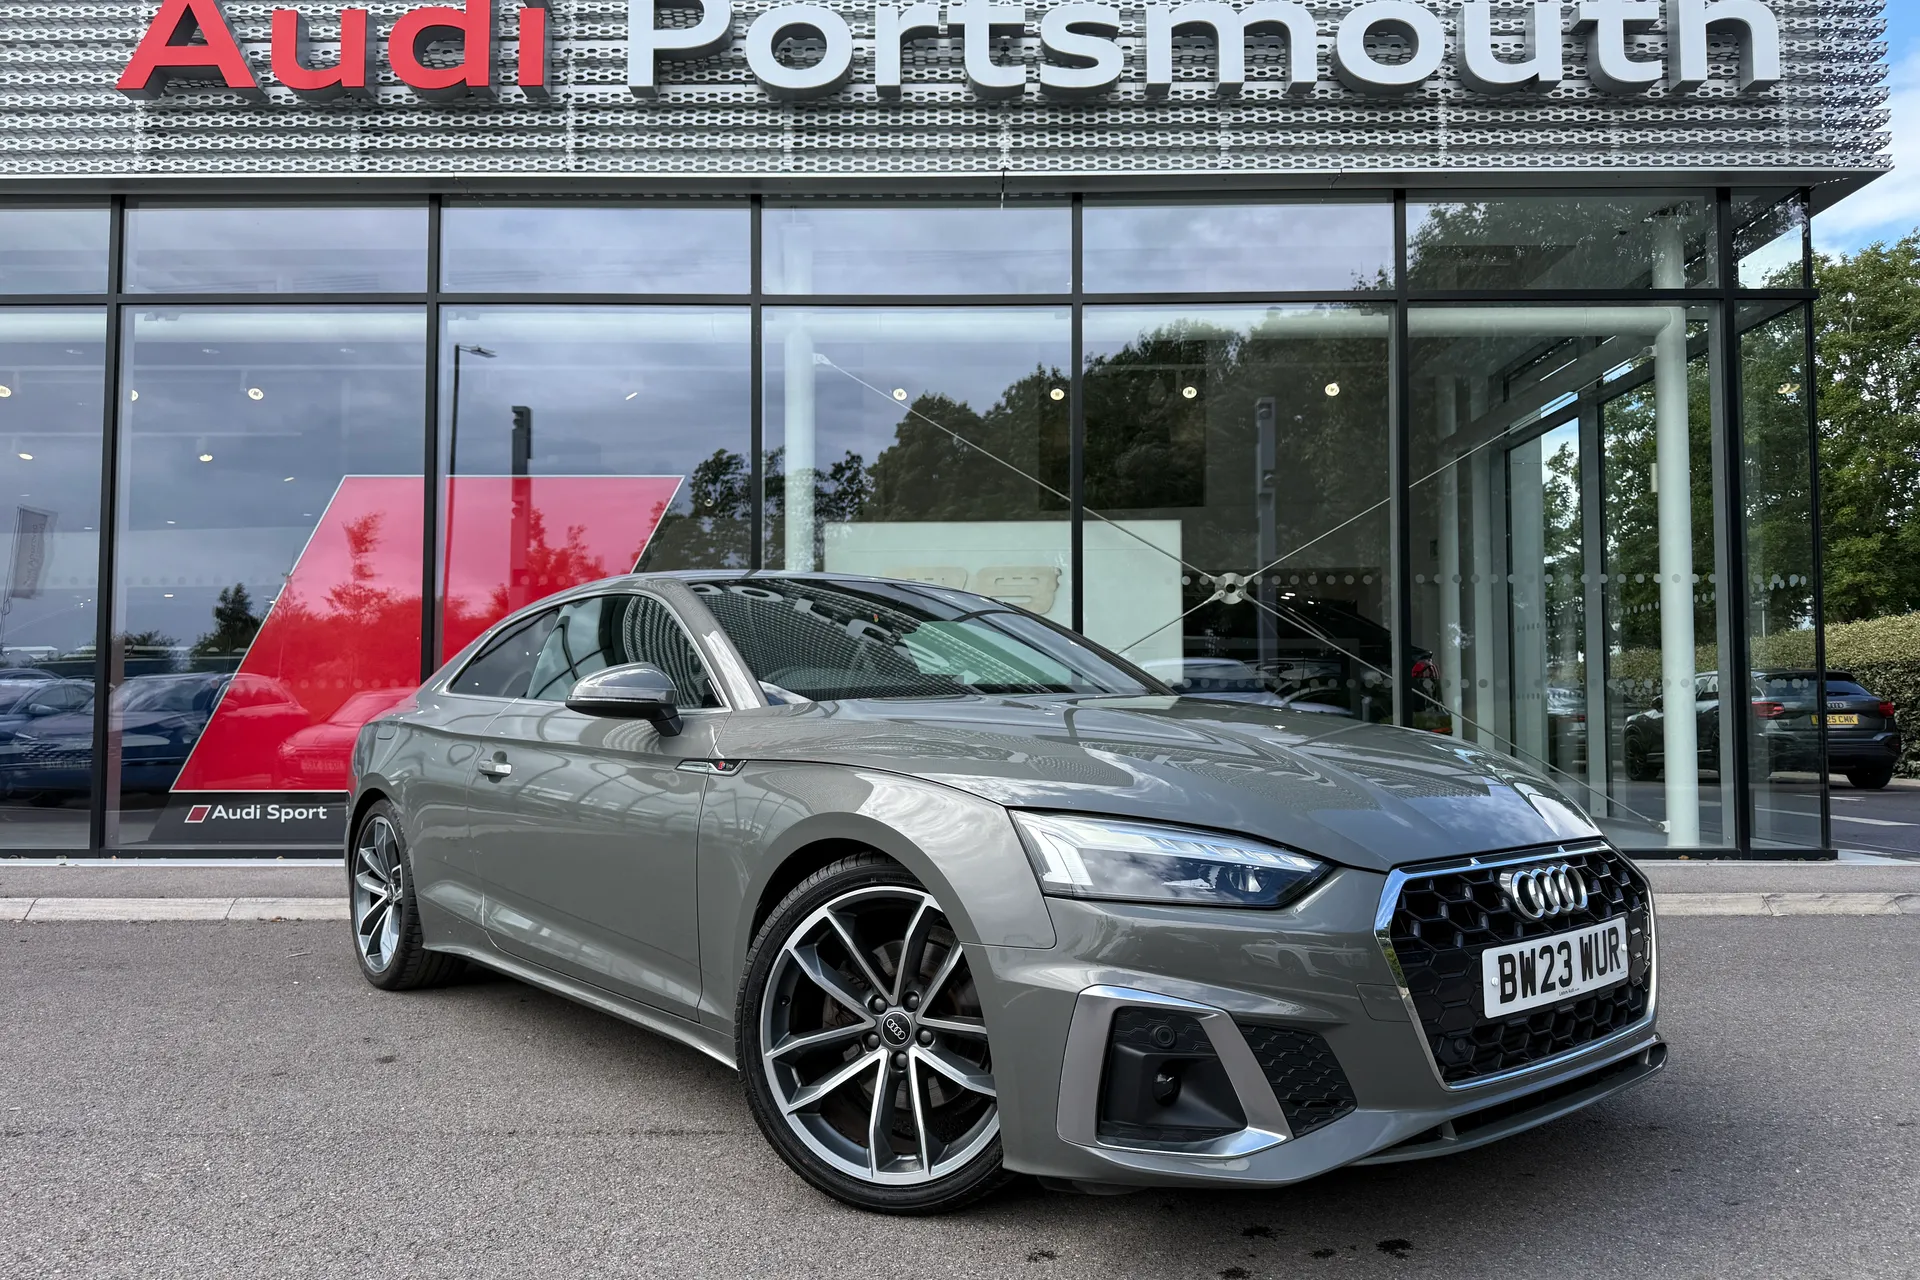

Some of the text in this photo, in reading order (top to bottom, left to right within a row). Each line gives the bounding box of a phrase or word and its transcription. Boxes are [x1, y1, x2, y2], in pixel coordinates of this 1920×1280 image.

[115, 0, 1781, 91] Audi Portsmouth
[211, 804, 328, 823] Audi Sport
[1497, 926, 1621, 1004] BW23 WUR
